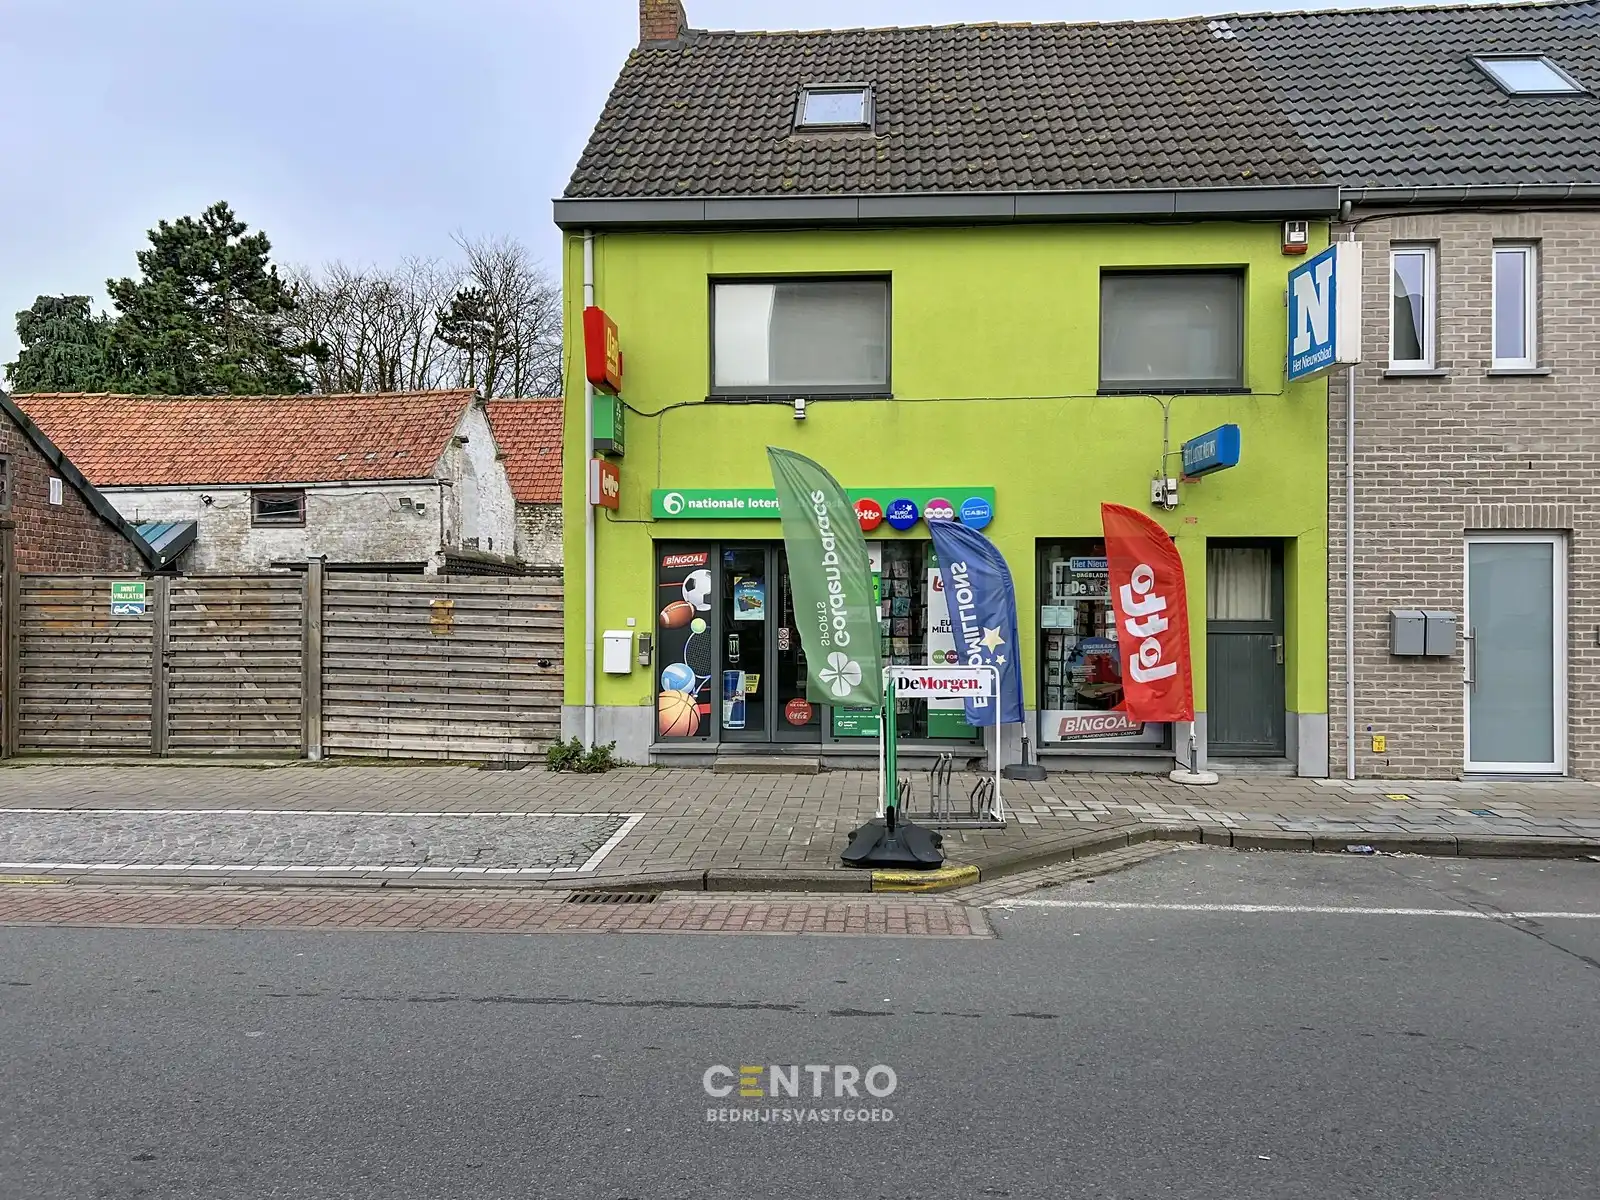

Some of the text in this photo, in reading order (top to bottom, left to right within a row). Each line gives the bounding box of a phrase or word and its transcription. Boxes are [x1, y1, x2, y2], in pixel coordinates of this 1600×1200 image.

[1293, 256, 1333, 357] N
[1292, 345, 1333, 373] Het Nieuwsblad
[688, 497, 781, 511] nationale loteri
[1073, 560, 1109, 568] Het Nieuw
[1072, 581, 1087, 594] De
[941, 619, 952, 627] EU
